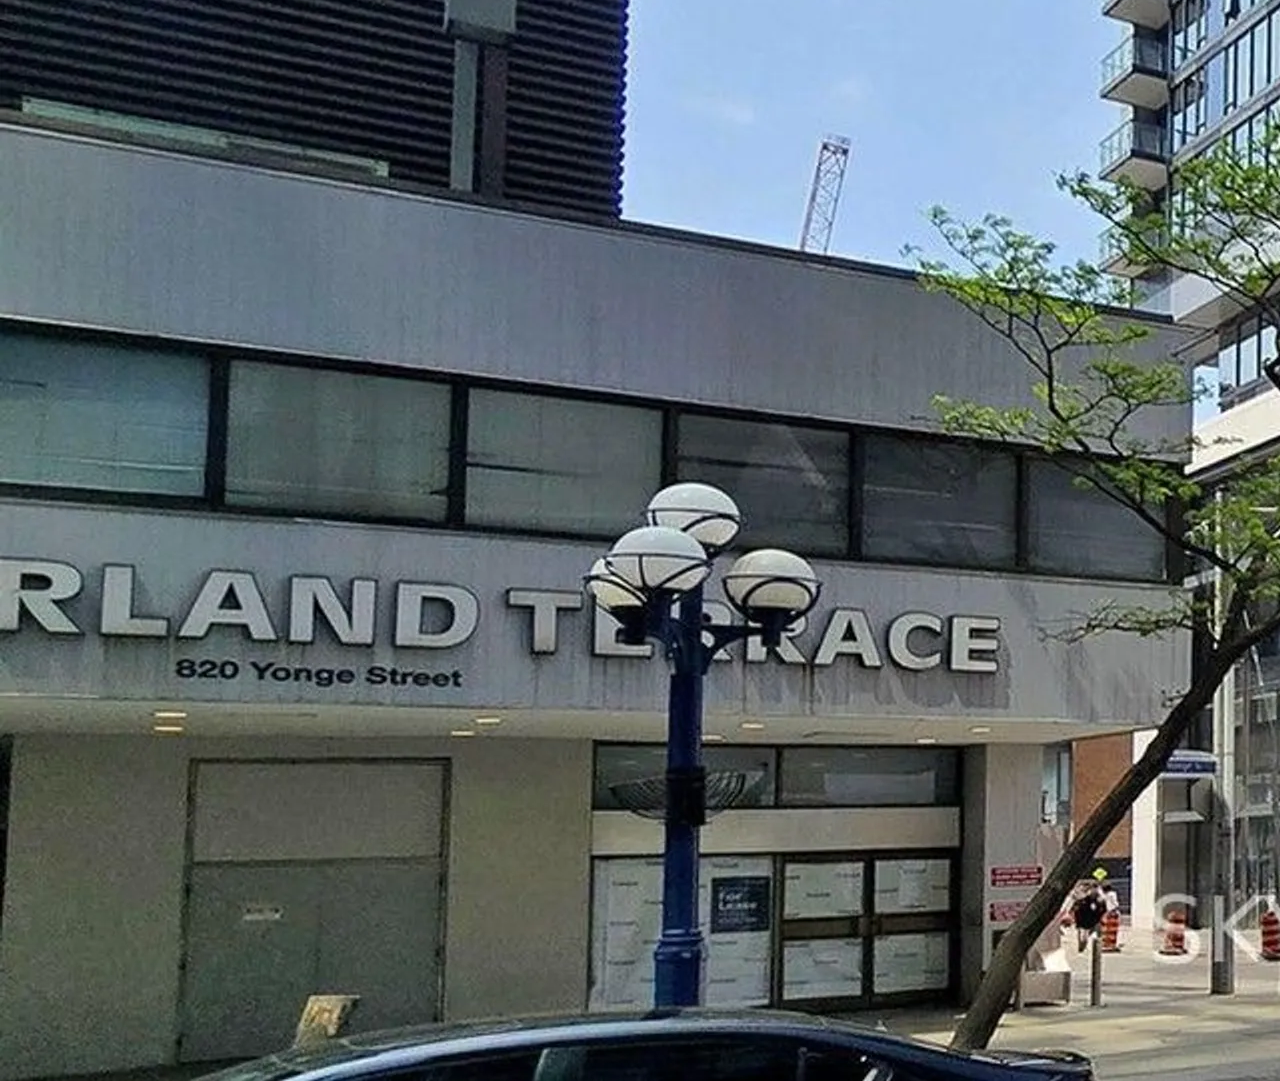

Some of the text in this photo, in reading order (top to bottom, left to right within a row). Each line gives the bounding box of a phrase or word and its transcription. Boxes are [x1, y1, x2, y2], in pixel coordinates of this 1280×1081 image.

[176, 659, 463, 687] 820 Yonge Street
